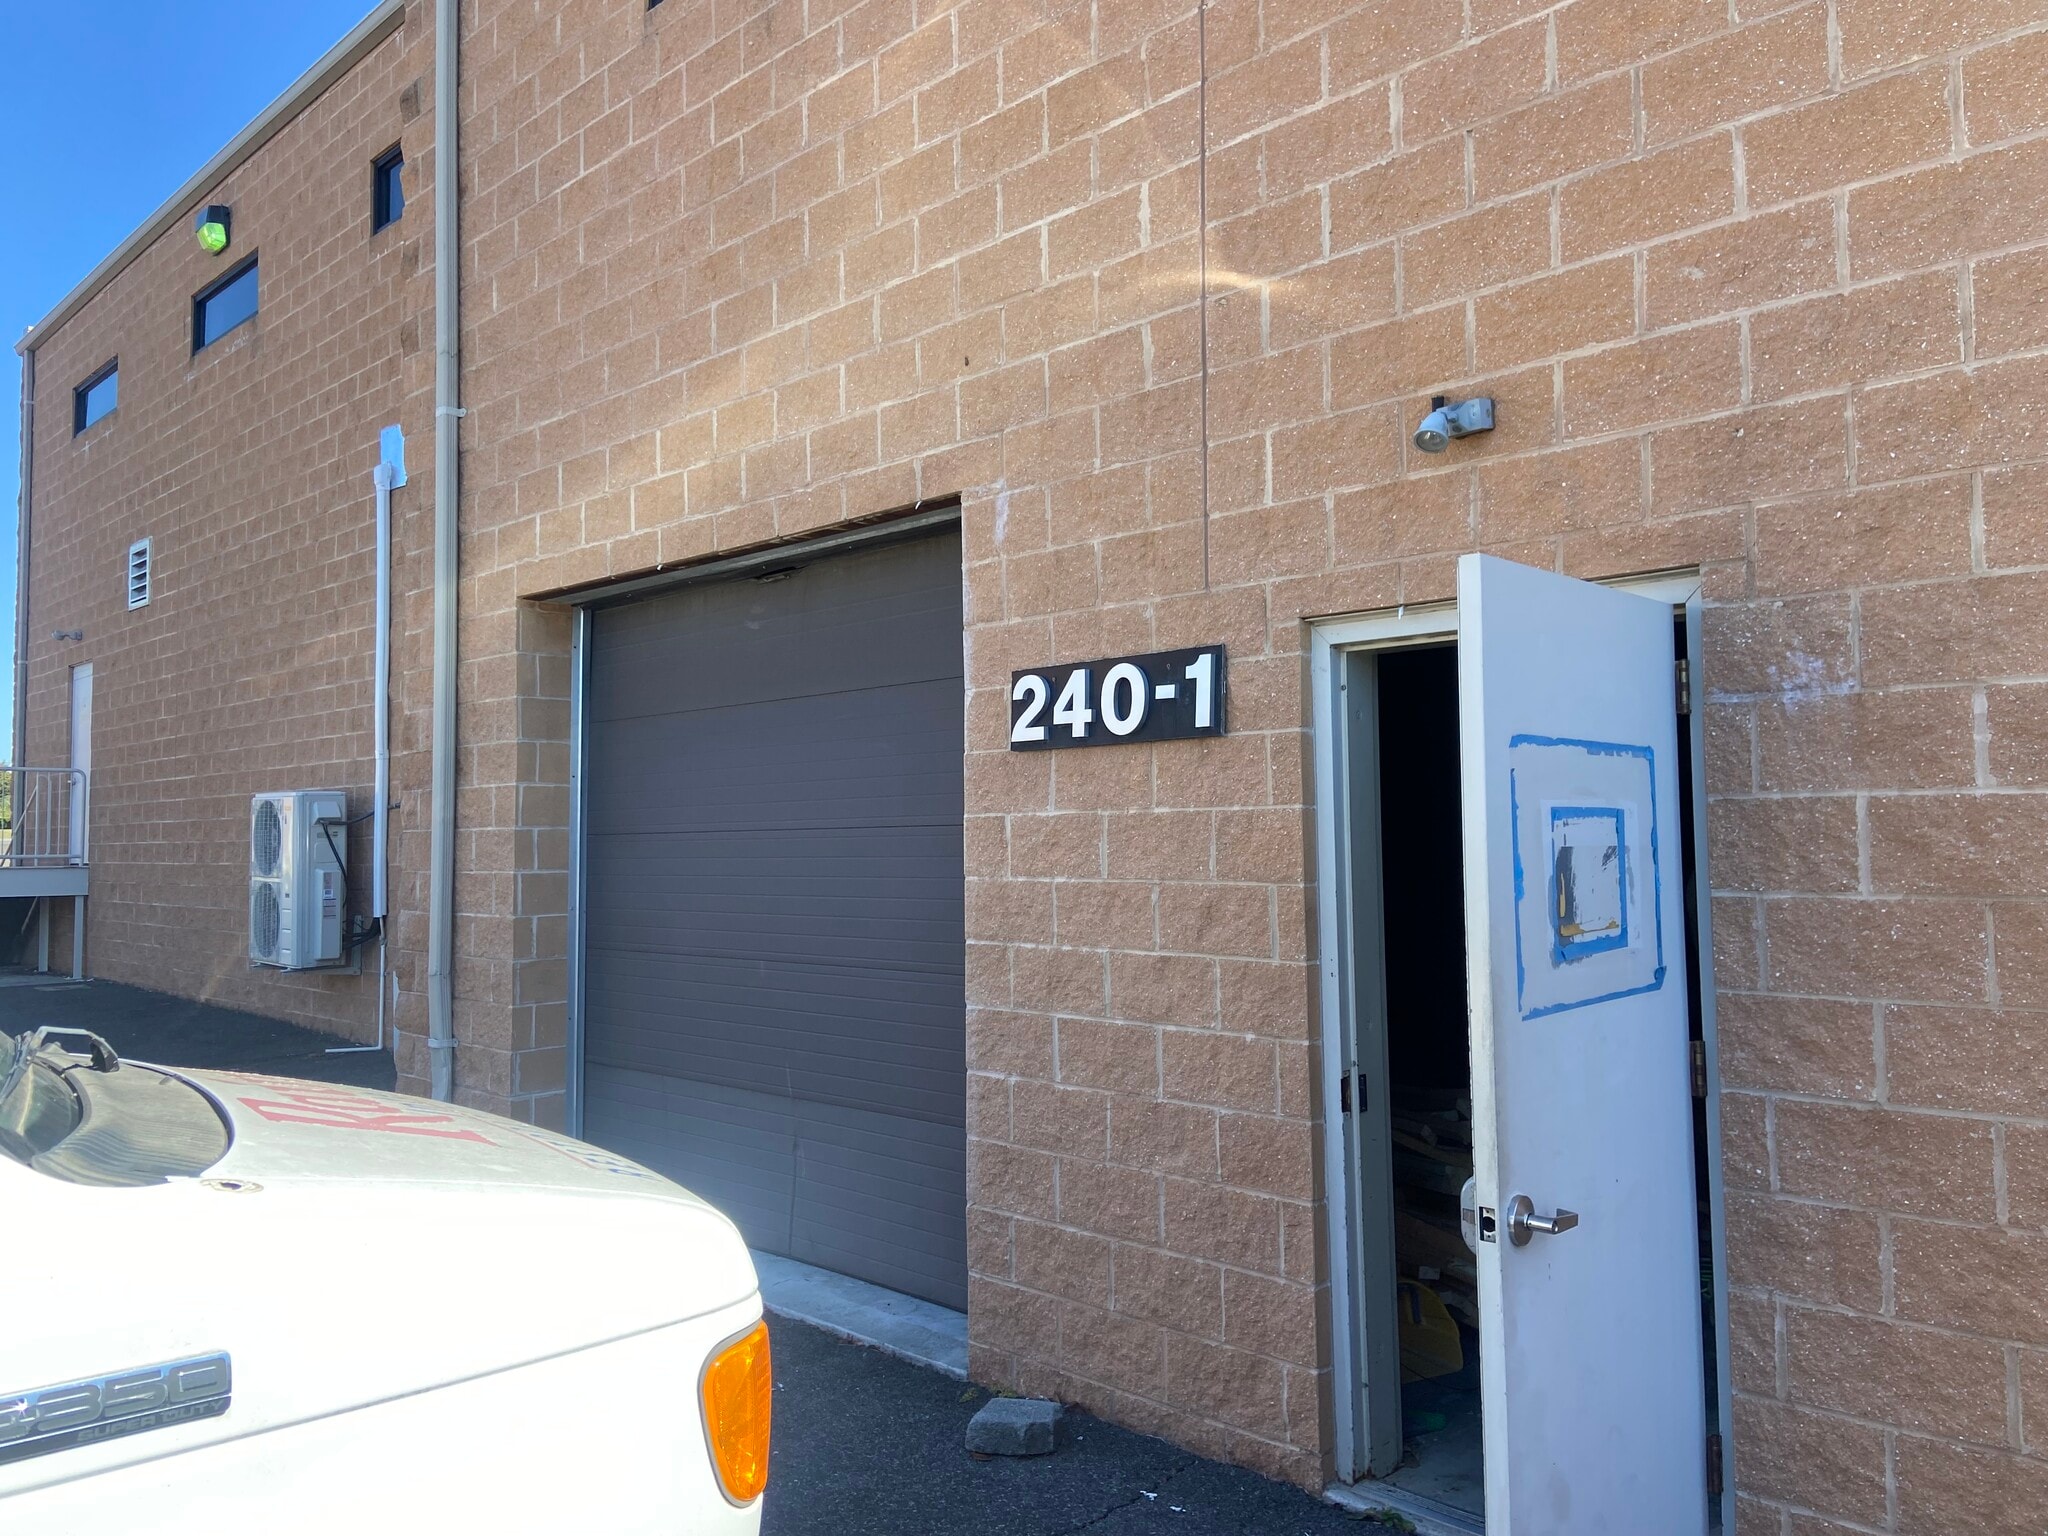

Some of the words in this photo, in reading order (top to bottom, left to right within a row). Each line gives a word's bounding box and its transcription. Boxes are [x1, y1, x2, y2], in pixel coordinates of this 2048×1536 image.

[1011, 653, 1215, 742] 240-1
[77, 1415, 156, 1442] SUPER
[162, 1400, 224, 1422] DUTY
